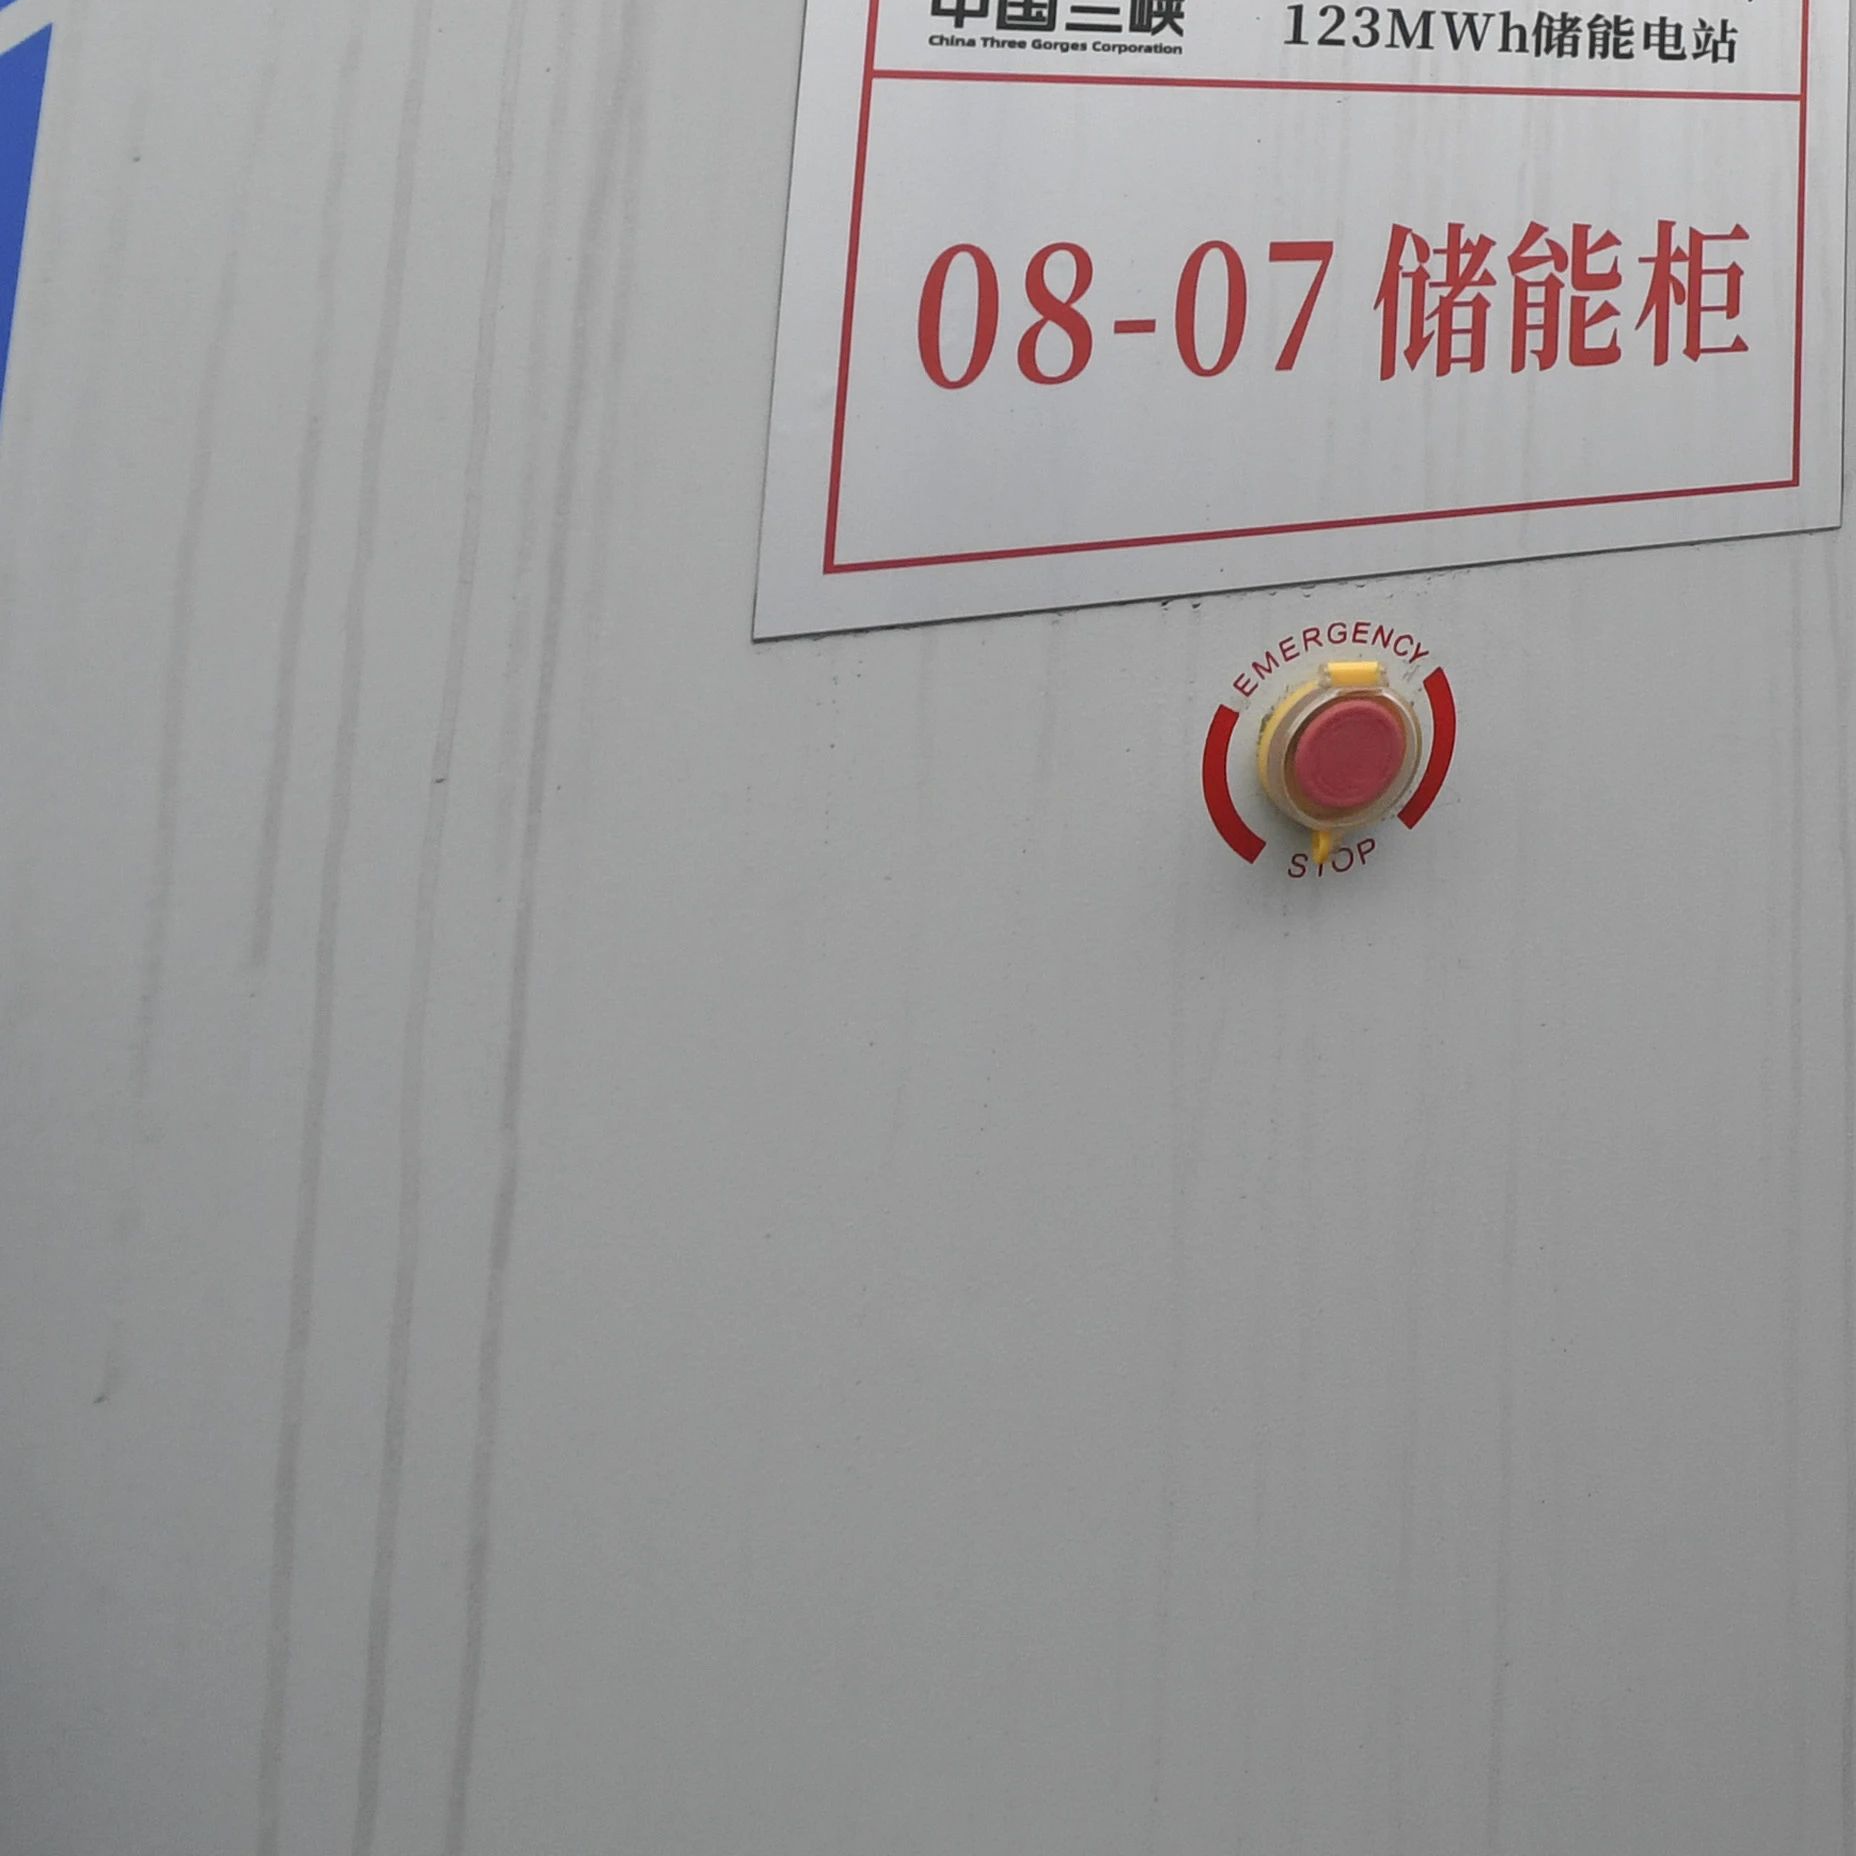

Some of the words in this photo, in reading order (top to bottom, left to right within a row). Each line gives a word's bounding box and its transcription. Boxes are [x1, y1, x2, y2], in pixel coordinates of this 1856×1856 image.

[928, 34, 977, 48] China
[980, 36, 1027, 50] Three
[1031, 38, 1088, 54] Gorges
[1092, 41, 1183, 56] Corporation
[1283, 4, 1738, 64] 123MWh储能电站
[918, 240, 1335, 391] 08-07
[1375, 219, 1750, 382] 储能柜
[1232, 621, 1430, 698] EMERGENCY
